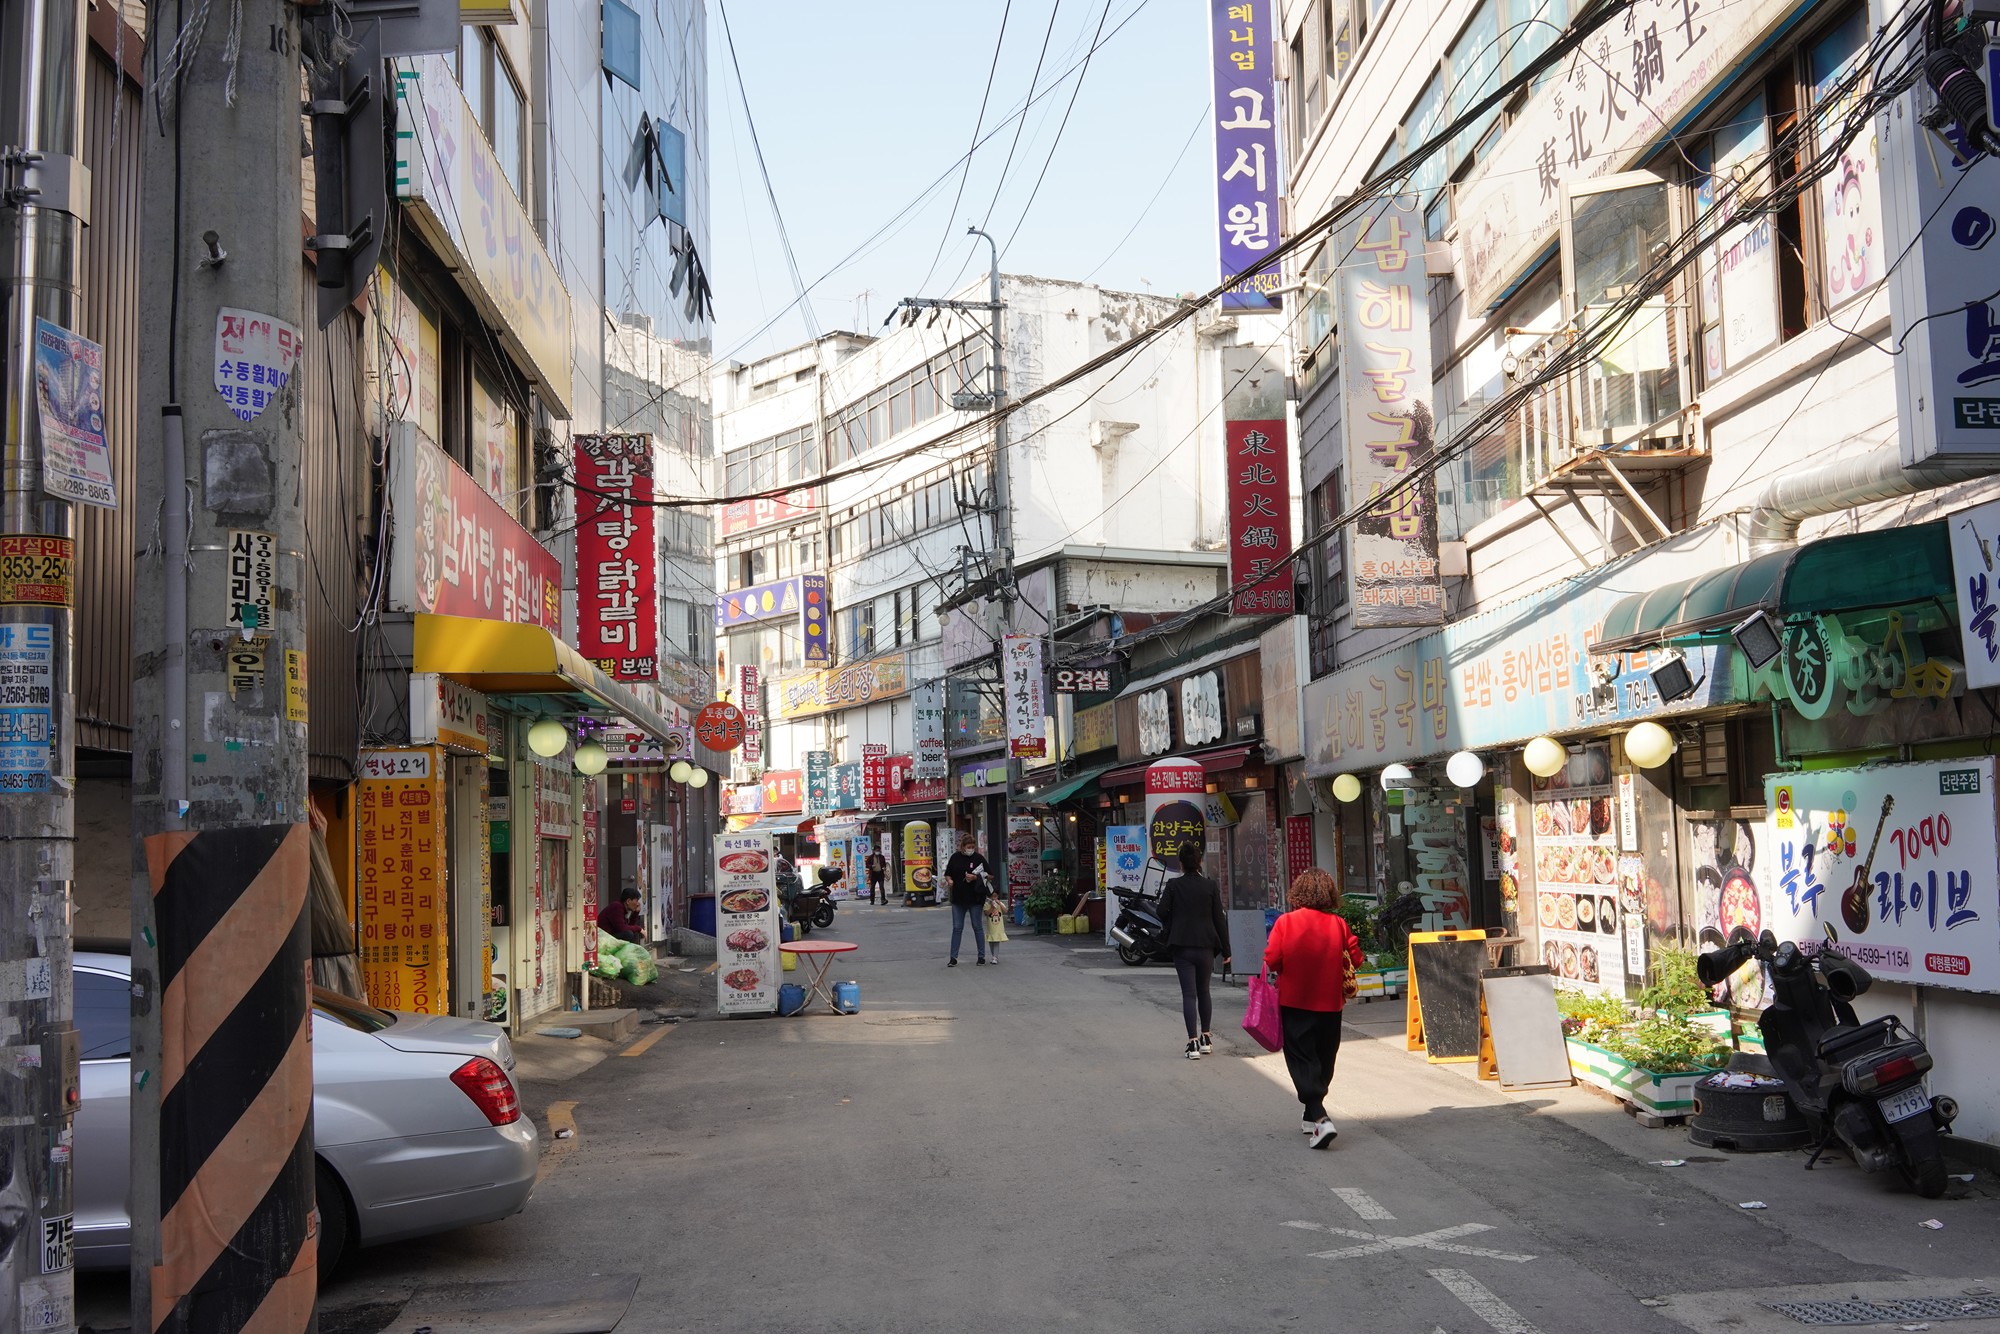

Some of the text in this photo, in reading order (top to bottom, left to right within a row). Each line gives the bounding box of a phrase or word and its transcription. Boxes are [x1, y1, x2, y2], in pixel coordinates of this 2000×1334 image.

[1220, 86, 1272, 250] 고시원
[1355, 216, 1425, 540] 남해굴국밥
[584, 436, 645, 456] 강원집
[1361, 558, 1436, 579] 홍어삼합
[804, 577, 825, 589] sbs
[1362, 585, 1437, 606] 돼지갈비
[620, 657, 654, 676] 보쌈
[1056, 670, 1109, 691] 오겹살
[1324, 656, 1448, 760] 남해굴국밥
[698, 720, 743, 742] 순대국
[920, 738, 943, 748] coffee
[922, 752, 943, 762] beer
[975, 768, 987, 788] CU
[1941, 773, 1979, 792] 단란주점
[1152, 820, 1204, 837] 한양국수
[1124, 856, 1134, 867] 冷
[1874, 869, 1980, 933] 라이브
[1894, 1096, 1926, 1117] 7191
